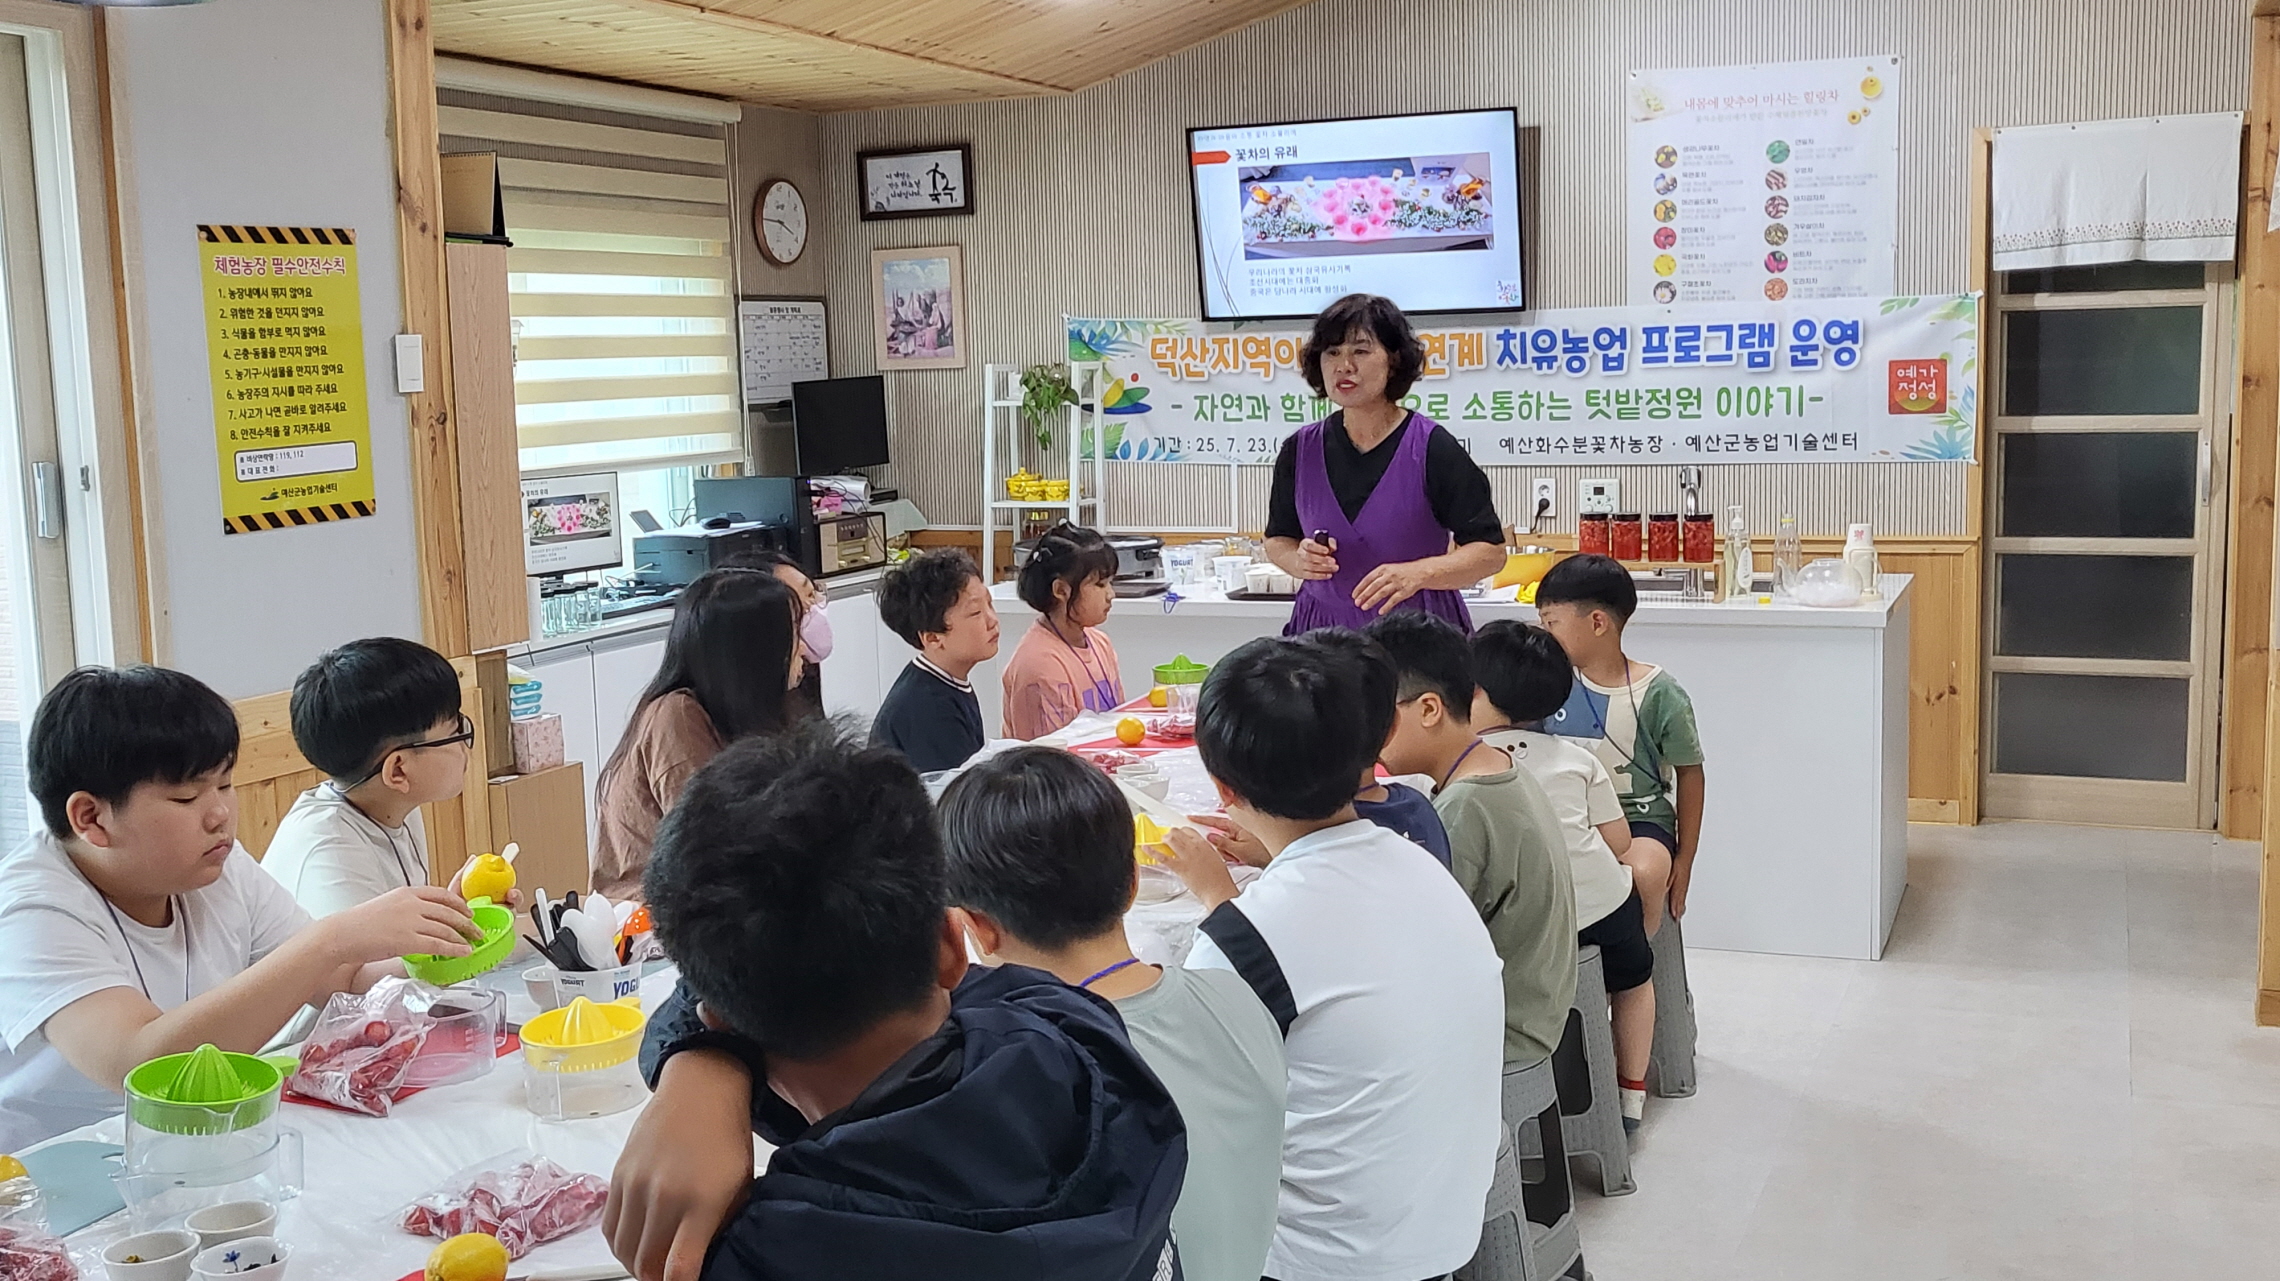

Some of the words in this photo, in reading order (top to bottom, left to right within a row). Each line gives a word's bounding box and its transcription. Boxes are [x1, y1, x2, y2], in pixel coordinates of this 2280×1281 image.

[1685, 97, 1719, 110] 내몸에
[1723, 94, 1758, 109] 맞추어
[1762, 92, 1799, 107] 마시는
[1803, 89, 1839, 104] 힐링차
[1235, 146, 1270, 161] 꽃차의
[1274, 145, 1298, 159] 유래
[214, 256, 267, 276] 체험농장
[271, 257, 346, 276] 필수안전수칙
[228, 287, 269, 299] 농장내에서
[289, 287, 313, 299] 않아요
[230, 307, 254, 319] 위험한
[257, 307, 273, 319] 것을
[301, 306, 325, 318] 않아요
[232, 328, 256, 340] 식물을
[258, 327, 283, 339] 함부로
[285, 326, 300, 338] 먹지
[303, 326, 326, 338] 않아요
[278, 346, 302, 358] 만지지
[304, 345, 328, 357] 않아요
[1150, 336, 1304, 378] 덕산지역아
[1420, 332, 1483, 376] 연계
[1496, 327, 1627, 374] 치유농업
[1642, 323, 1776, 369] 프로그램
[1789, 318, 1860, 368] 운영
[296, 365, 319, 376] 만지지
[321, 364, 344, 376] 않아요
[1896, 365, 1939, 379] 예가
[237, 387, 269, 400] 농장주의
[271, 385, 295, 397] 지시를
[297, 384, 313, 395] 따라
[315, 383, 338, 394] 주세요
[1898, 380, 1937, 400] 정성
[239, 408, 263, 419] 사고가
[265, 406, 282, 418] 나면
[284, 404, 307, 417] 곧바로
[309, 402, 347, 415] 알려주세요
[1193, 393, 1271, 422] 자연과
[1400, 393, 1450, 420] 으로
[1462, 389, 1572, 422] 소통하는
[1585, 387, 1702, 421] 텃밭정원
[241, 426, 280, 439] 안전수칙을
[283, 425, 291, 436] 잘
[293, 422, 332, 435] 지켜주세요
[1153, 436, 1182, 453] 기간
[1196, 437, 1220, 453] 25.
[1227, 437, 1240, 453] 7.
[1248, 436, 1278, 453] 23.(
[1499, 435, 1663, 454] 예산화수분꽃차농장
[1685, 432, 1858, 452] 예산군농업기술센터
[294, 450, 304, 459] 112
[281, 482, 338, 498] 예산군농업기술센터
[1170, 558, 1193, 567] YOGURT
[561, 977, 585, 987] YOGURT
